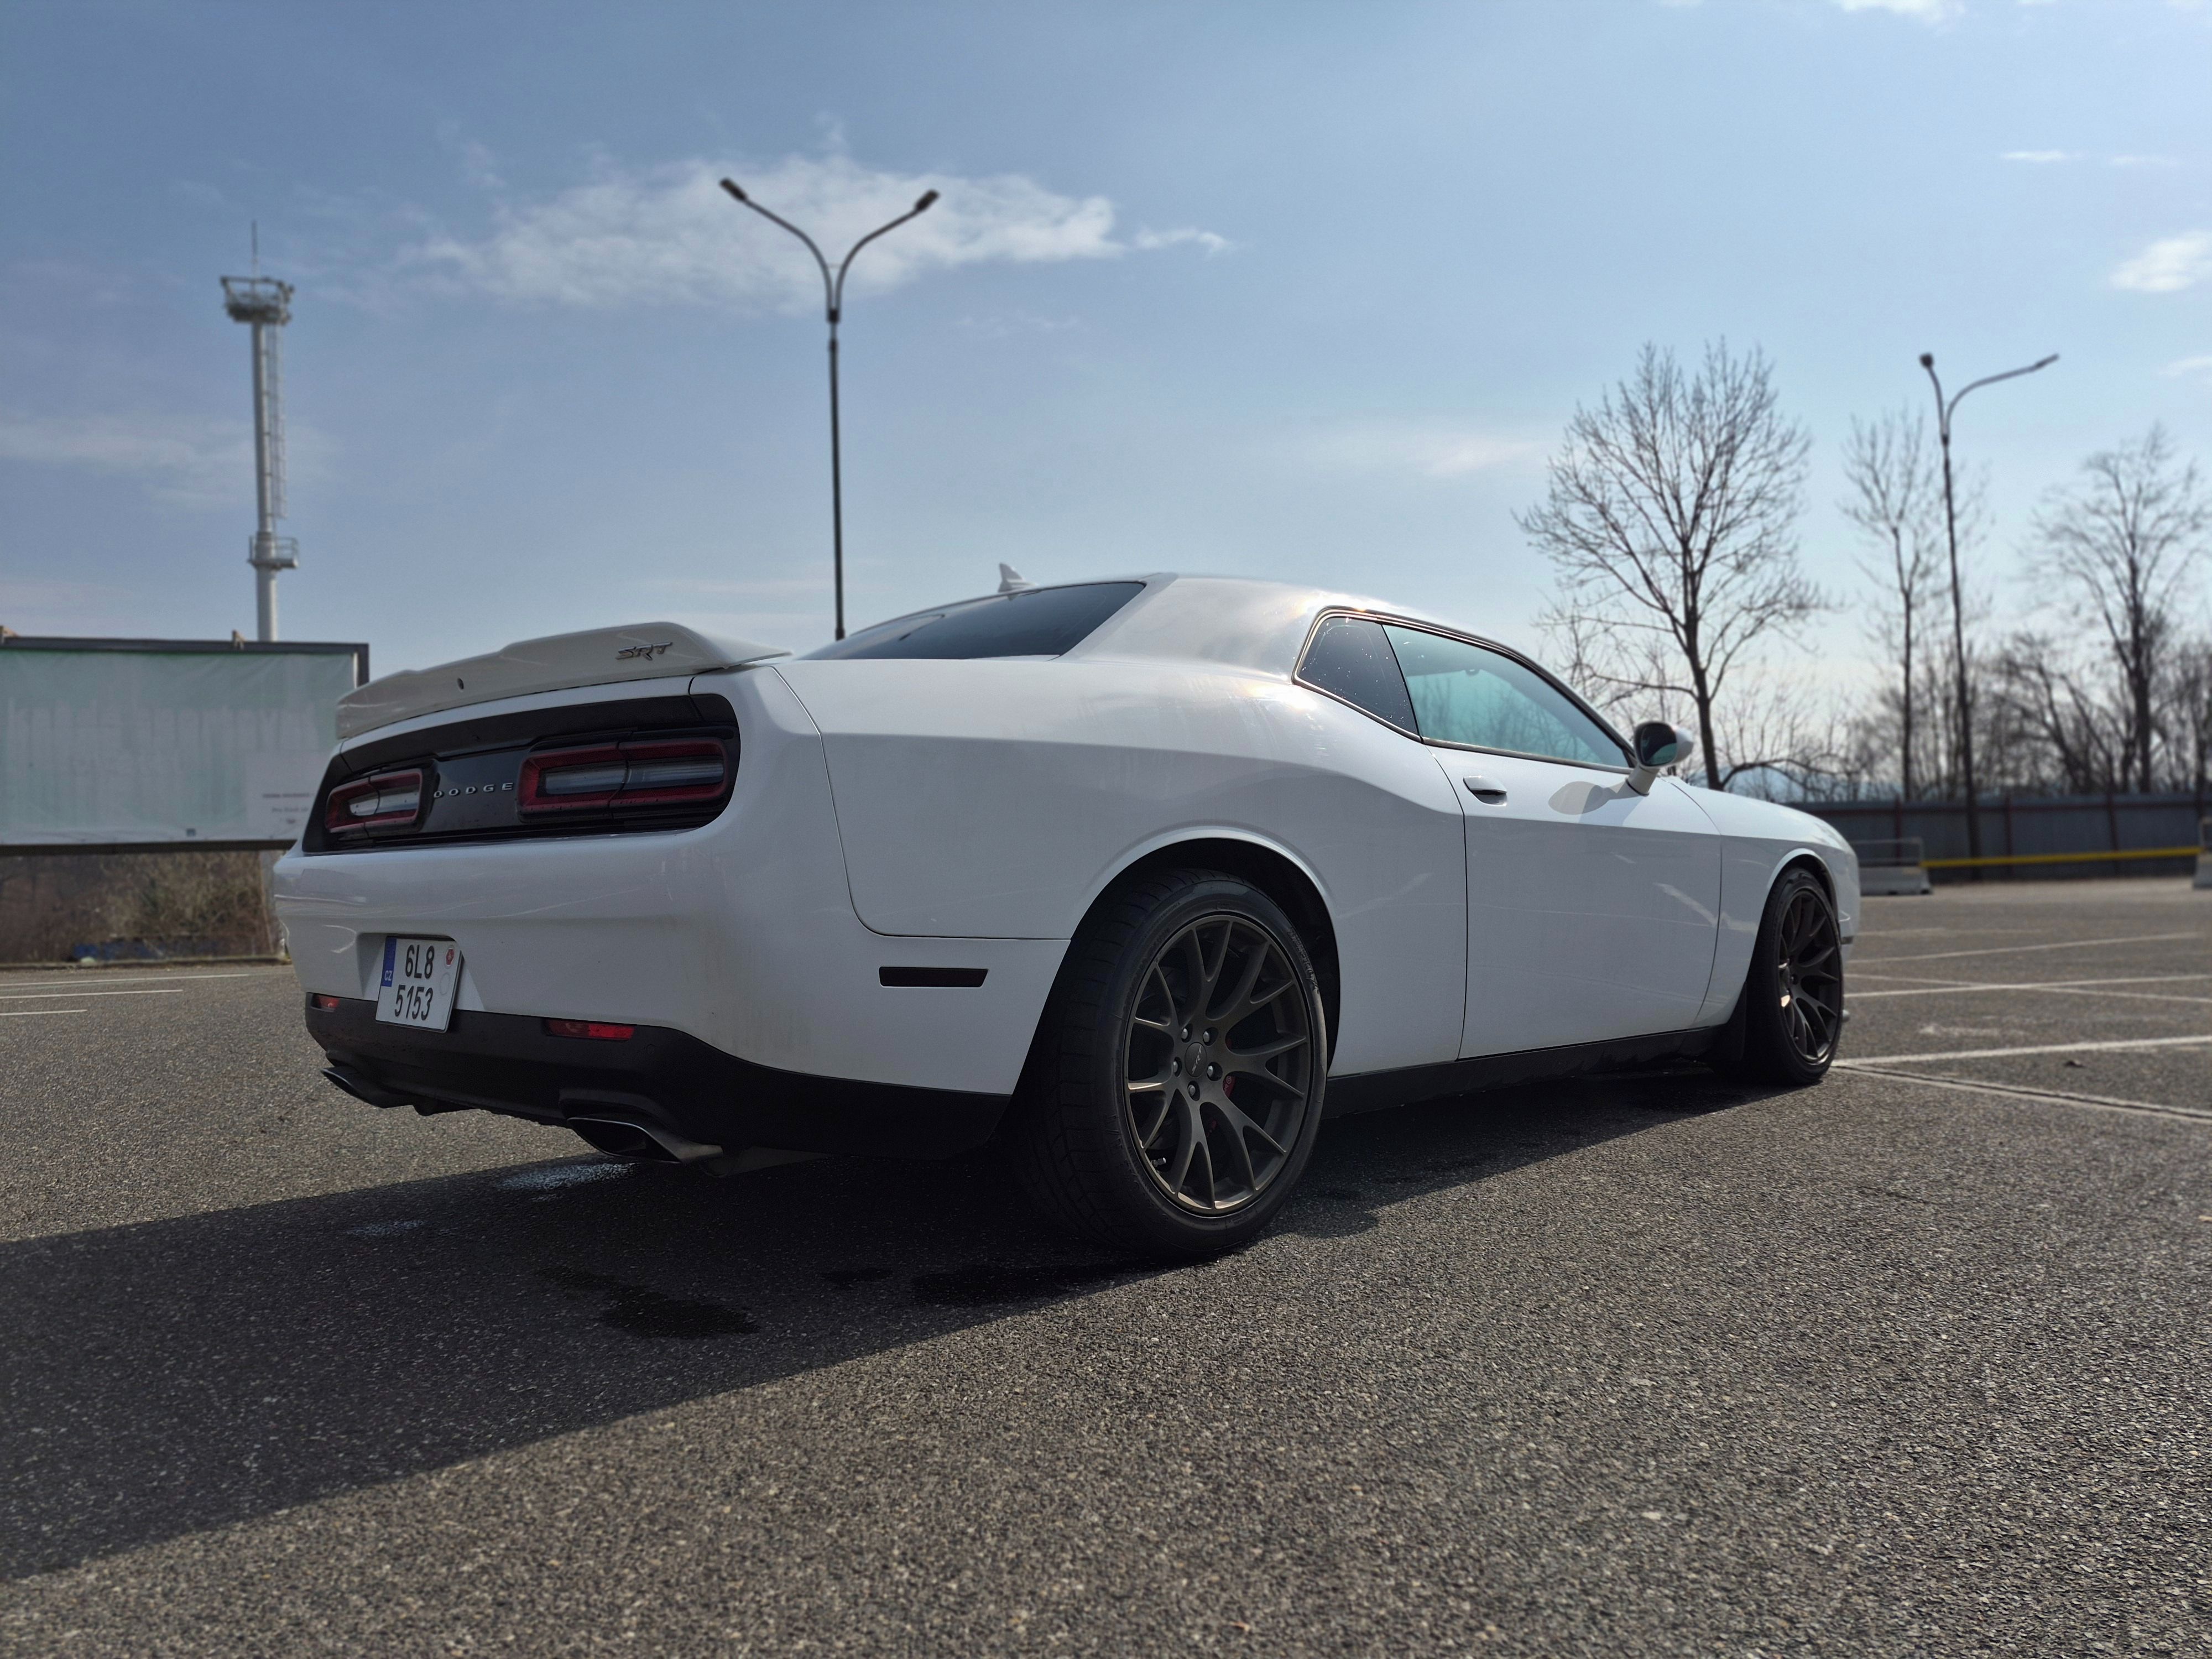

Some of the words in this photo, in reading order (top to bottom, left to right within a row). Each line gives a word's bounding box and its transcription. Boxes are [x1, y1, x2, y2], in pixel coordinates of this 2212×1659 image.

[615, 642, 672, 661] SRT
[434, 782, 514, 798] DODGE
[405, 945, 435, 979] 6L8
[384, 971, 392, 981] CZ
[394, 984, 433, 1020] 5153
